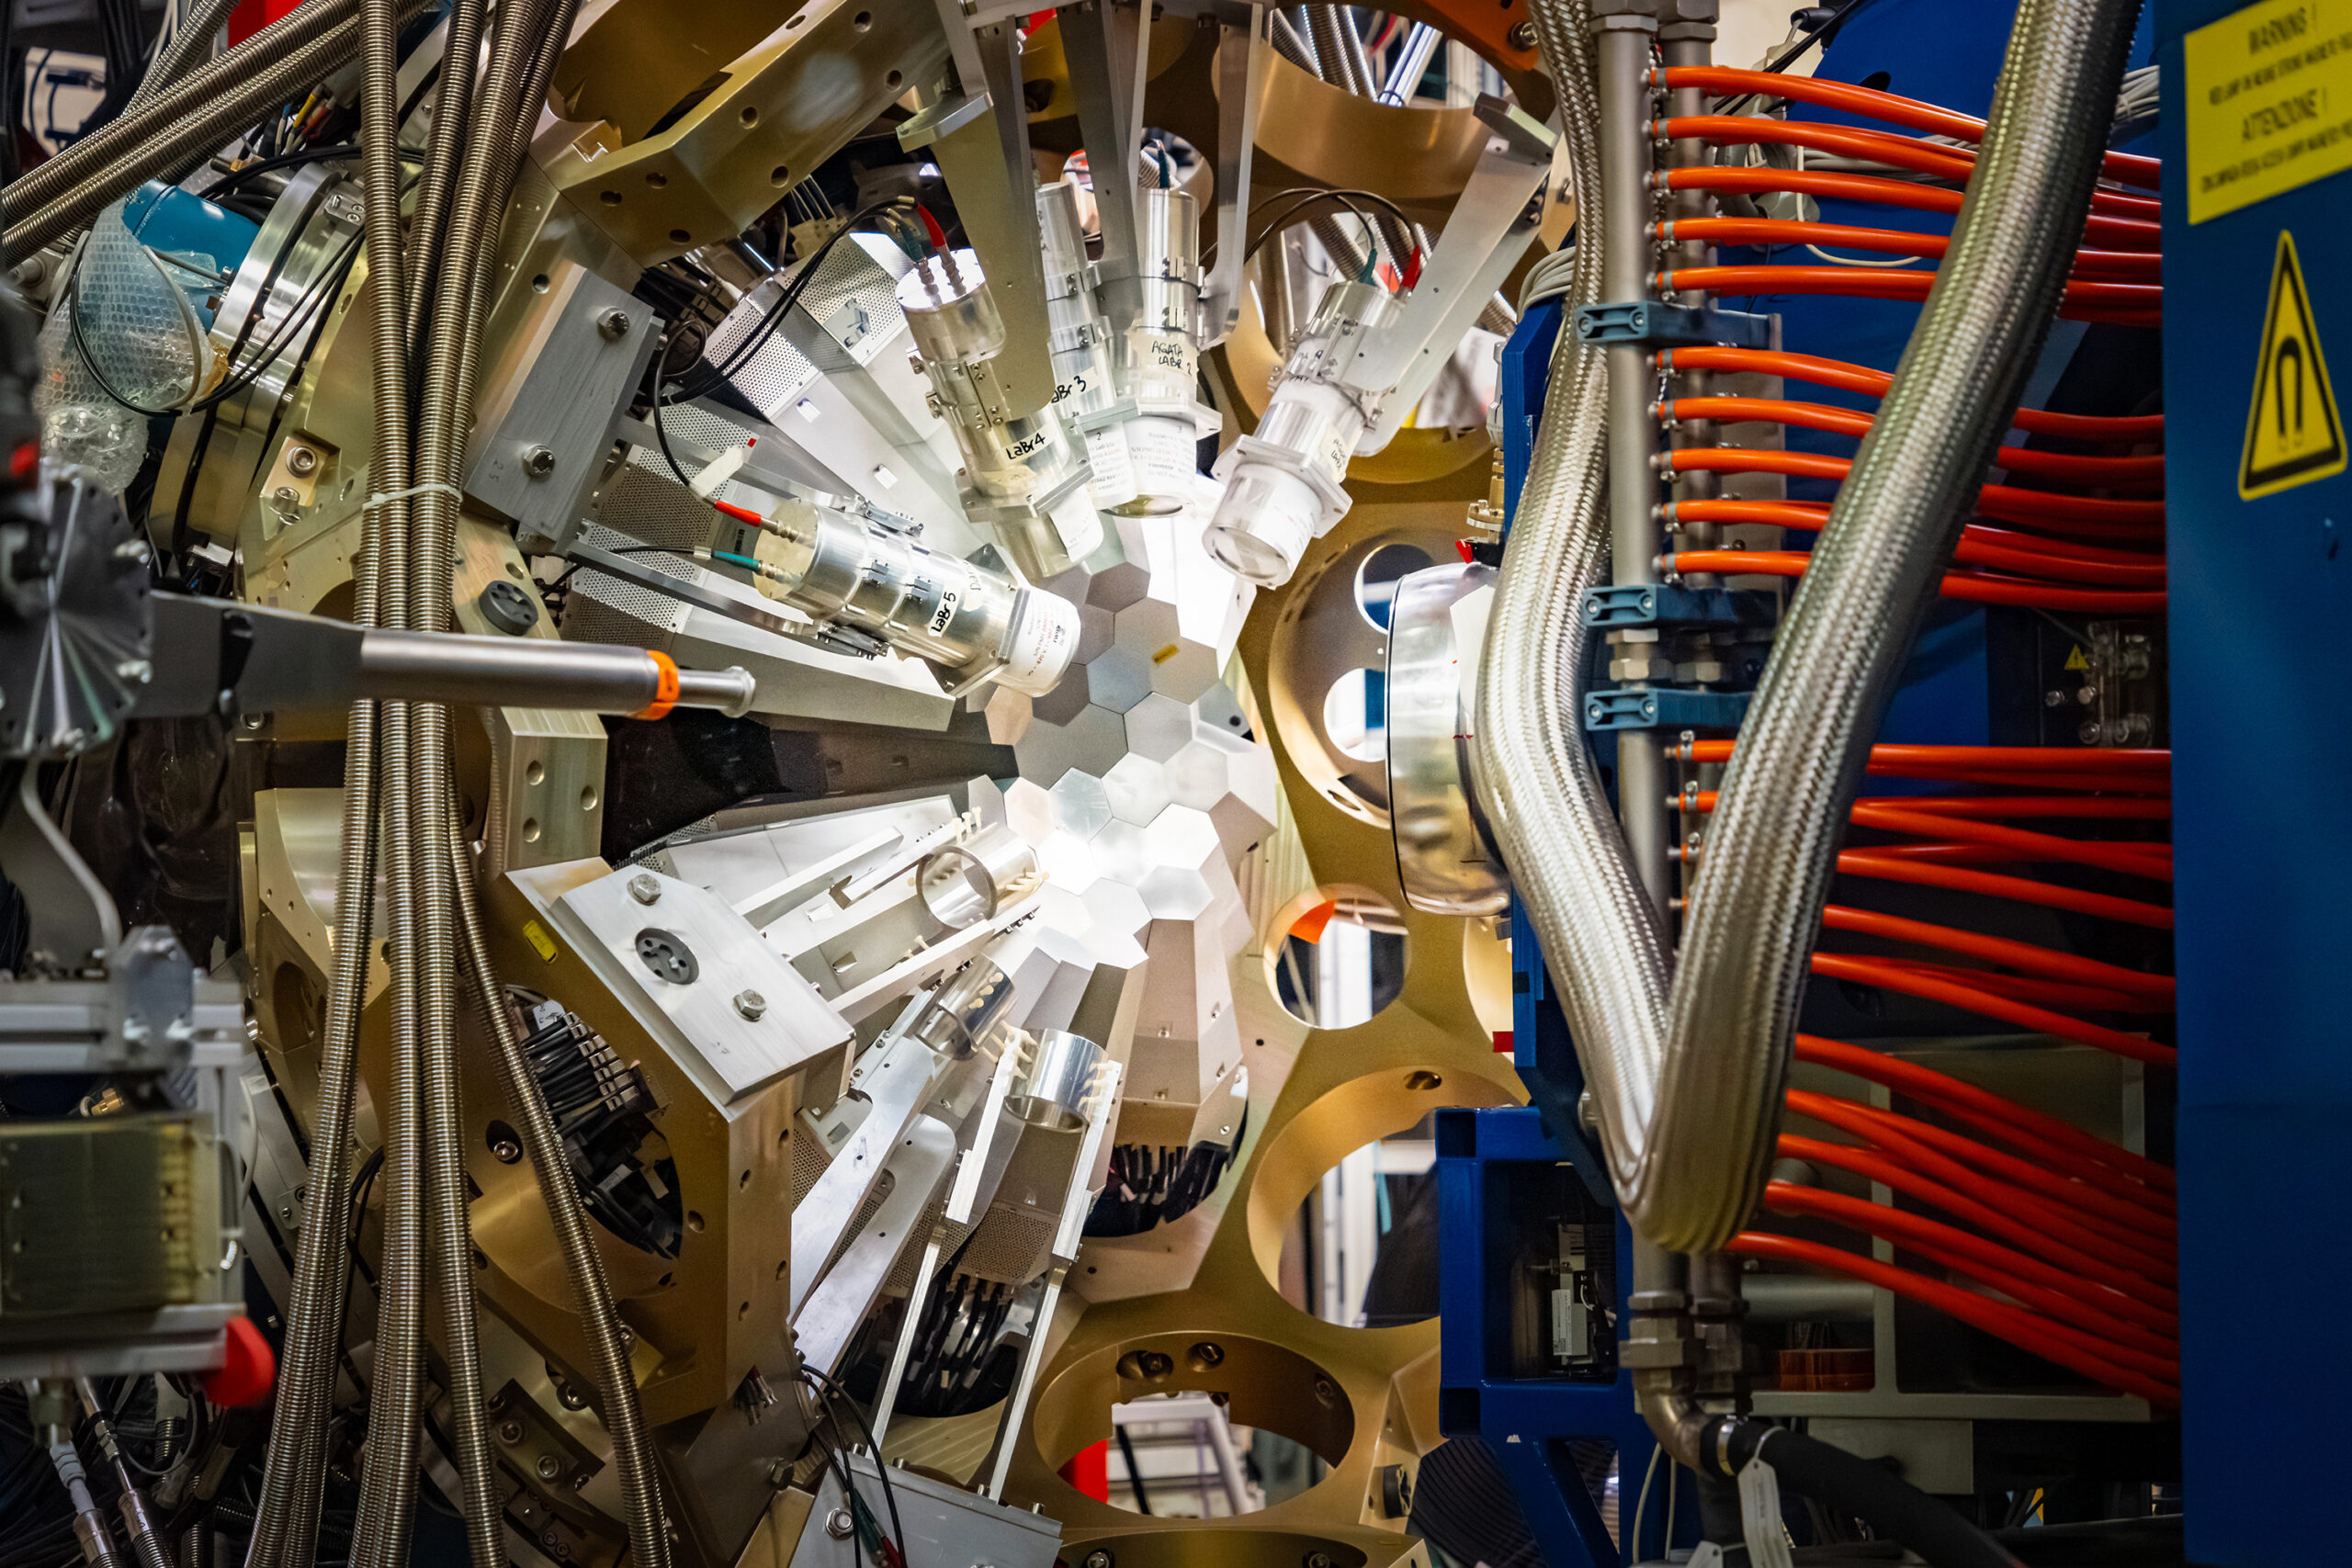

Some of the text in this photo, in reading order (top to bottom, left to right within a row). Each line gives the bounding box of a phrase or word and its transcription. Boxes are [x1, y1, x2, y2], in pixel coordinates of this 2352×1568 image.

[1151, 340, 1183, 357] AGATA
[1051, 375, 1087, 403] aBr 3
[931, 591, 956, 633] LaBr 5
